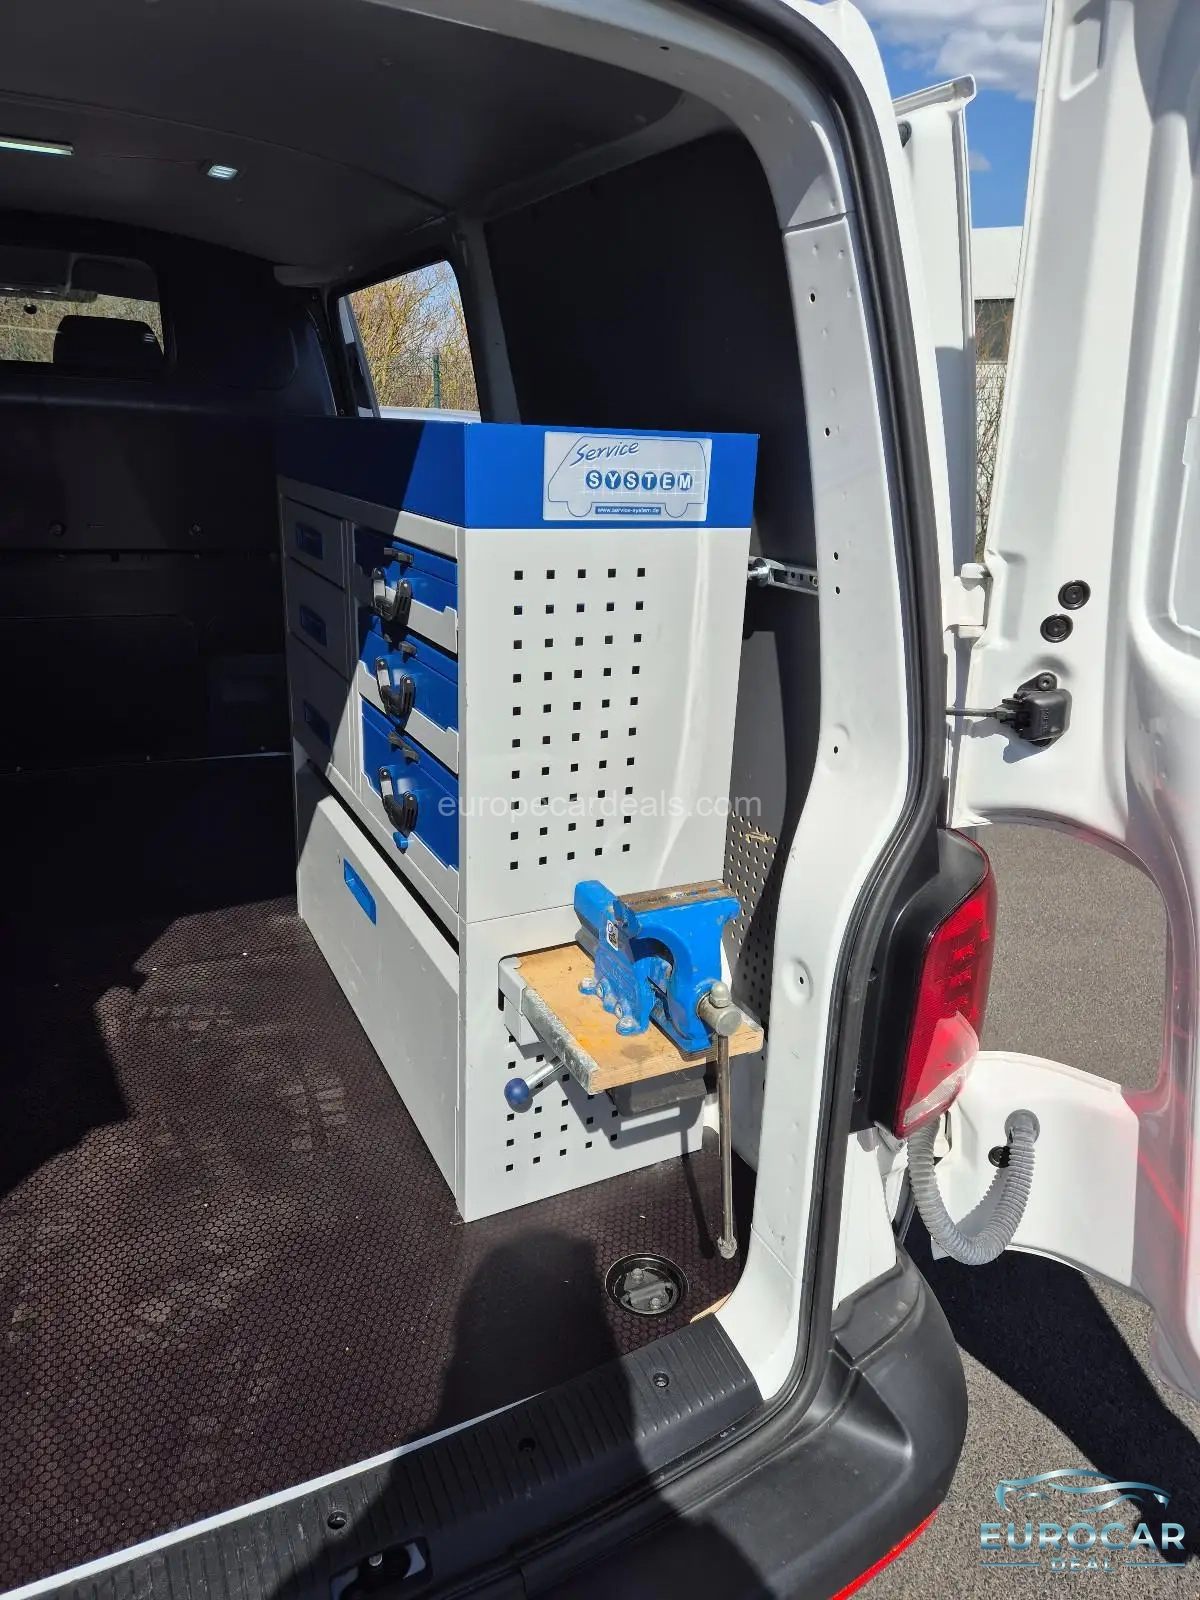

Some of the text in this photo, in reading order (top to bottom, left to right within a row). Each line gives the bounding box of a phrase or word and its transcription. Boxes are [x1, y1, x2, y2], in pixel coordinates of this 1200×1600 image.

[570, 442, 639, 466] Service
[587, 471, 692, 491] SYSTEM
[597, 507, 660, 515] www.service-system.de
